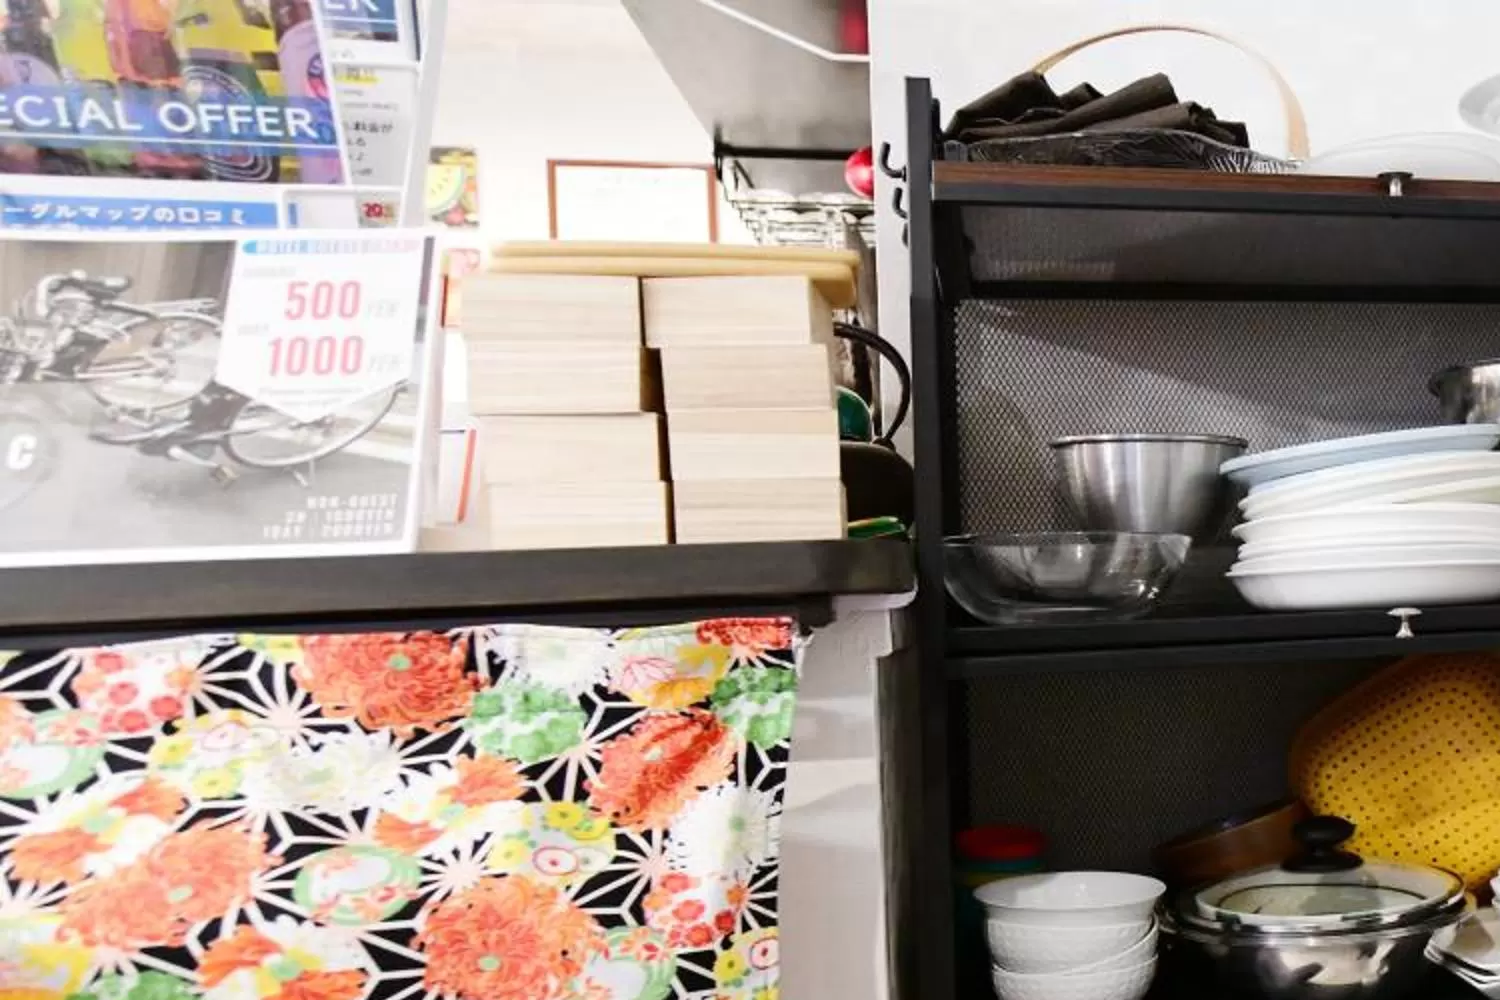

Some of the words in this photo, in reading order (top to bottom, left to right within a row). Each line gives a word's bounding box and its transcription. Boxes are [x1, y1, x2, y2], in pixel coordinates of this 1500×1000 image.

[158, 101, 320, 138] OFFER
[284, 280, 362, 320] 500
[268, 335, 364, 376] 1000
